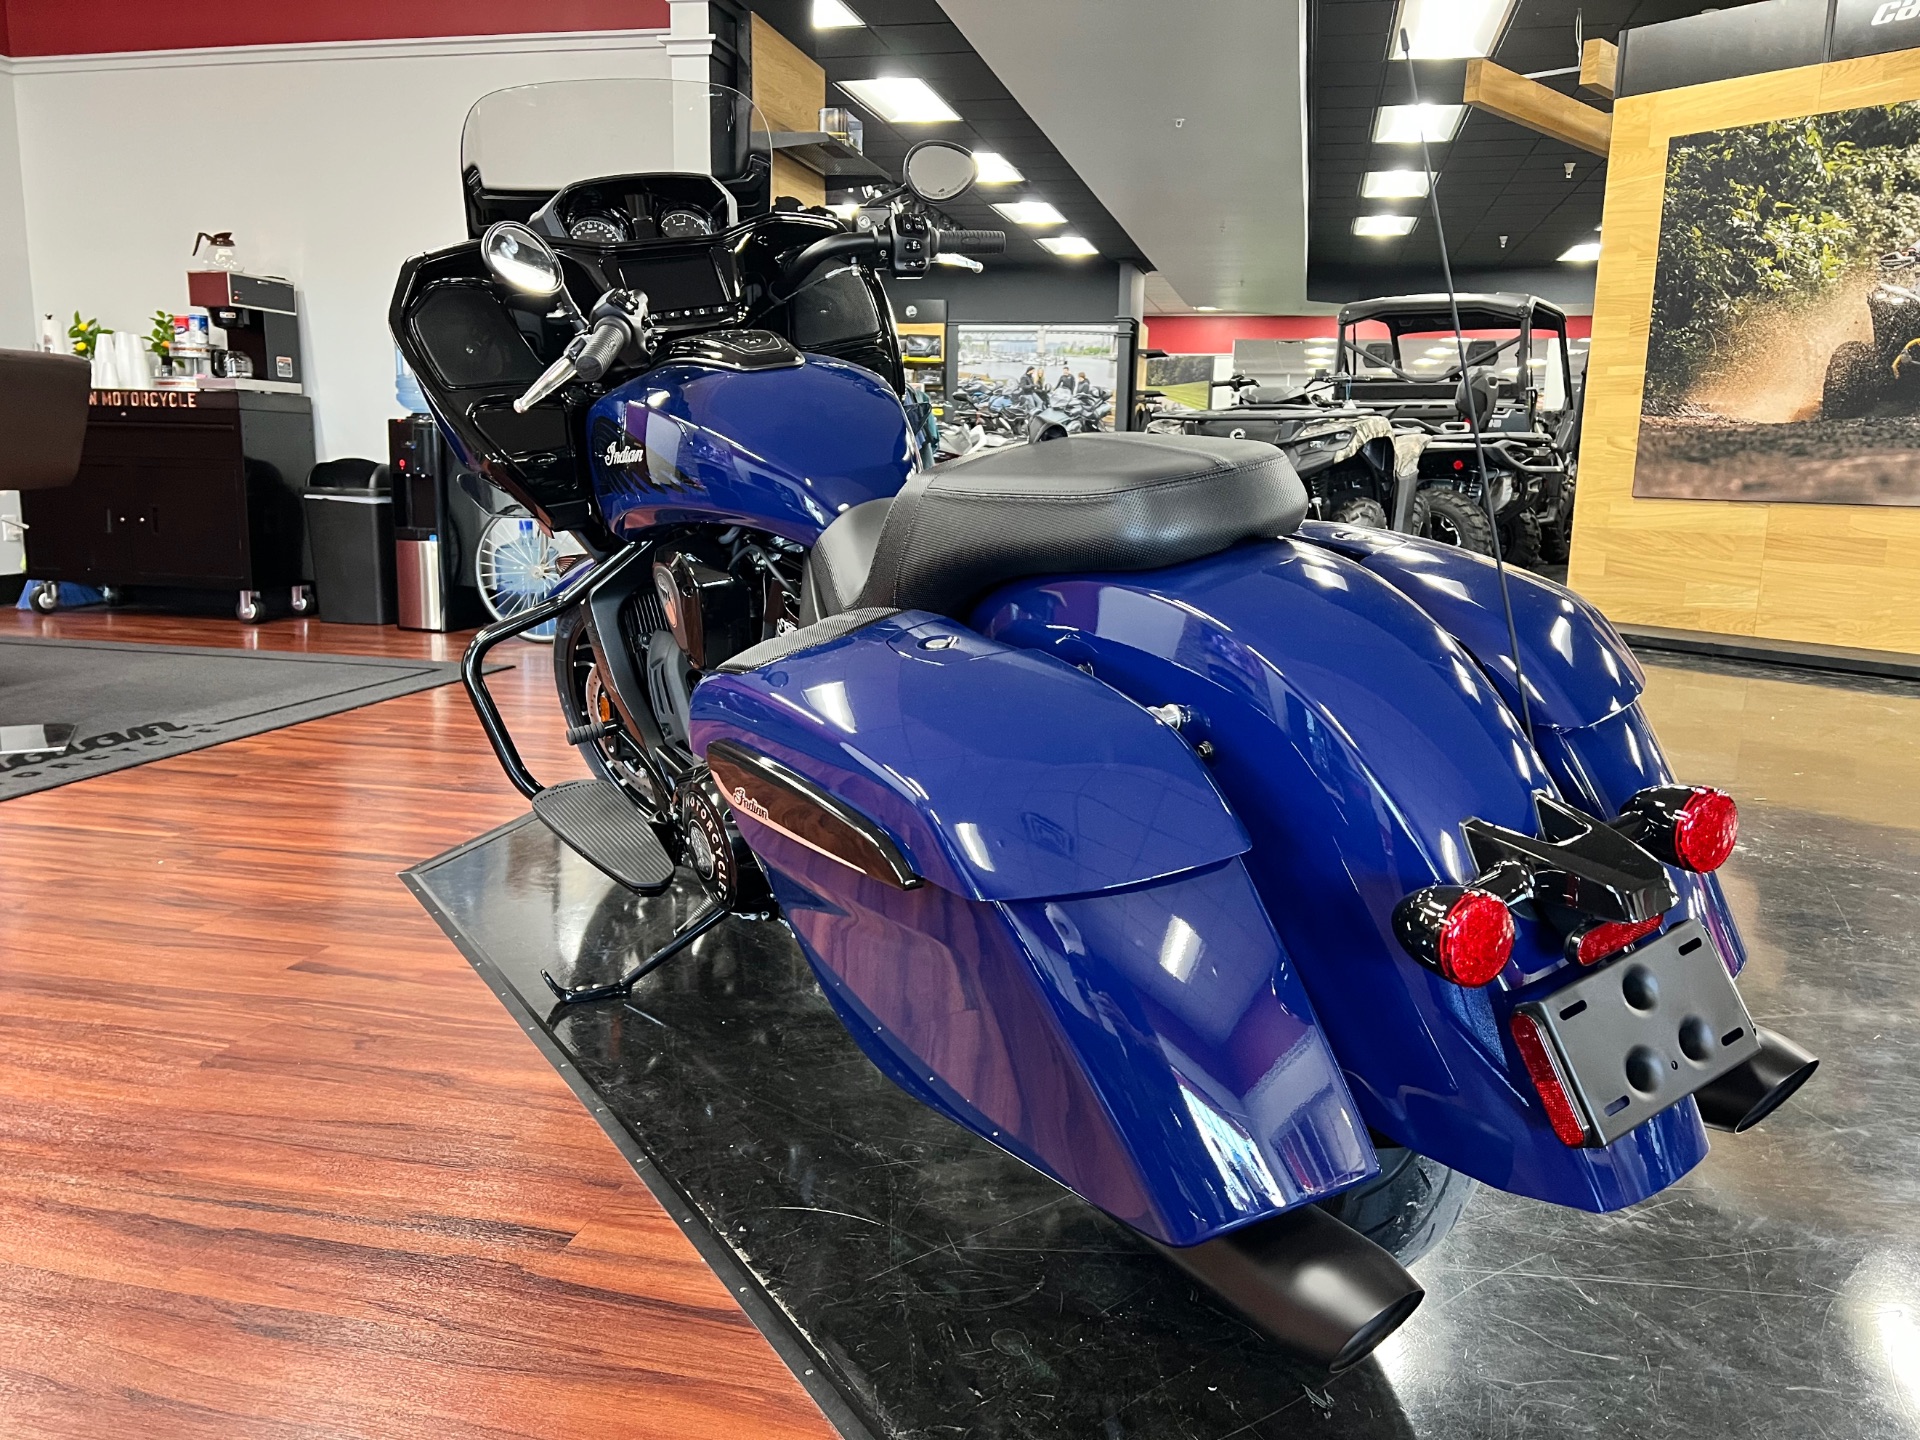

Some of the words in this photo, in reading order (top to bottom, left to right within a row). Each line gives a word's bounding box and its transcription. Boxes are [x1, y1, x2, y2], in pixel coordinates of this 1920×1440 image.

[1871, 0, 1920, 26] ca
[101, 391, 197, 408] MOTORCYCLE
[604, 441, 644, 466] Indian
[732, 786, 770, 821] Indian
[685, 795, 728, 893] MOTORCYCLE
